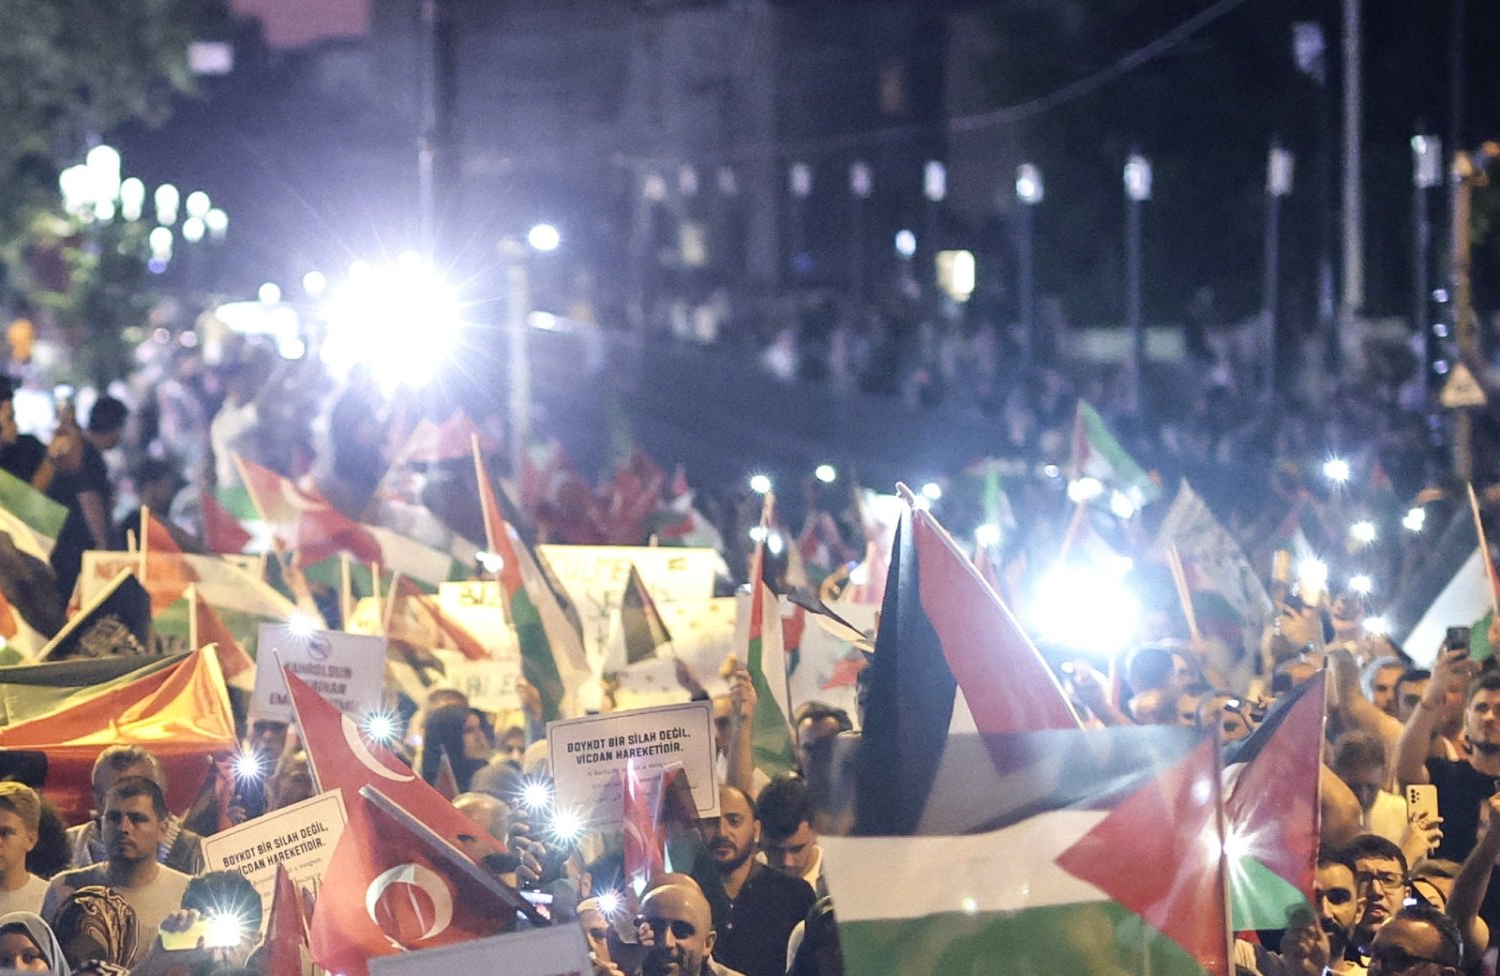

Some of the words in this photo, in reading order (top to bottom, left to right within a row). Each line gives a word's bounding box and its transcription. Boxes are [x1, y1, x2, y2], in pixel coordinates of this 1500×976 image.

[567, 738, 605, 753] BOYKOT
[608, 735, 626, 748] BİR
[628, 731, 657, 745] SİLAH
[576, 751, 613, 765] VİCDAN
[222, 847, 256, 868] BOYKOT
[257, 841, 273, 855] BİR
[273, 832, 299, 849] SİLAH
[237, 859, 266, 876] İCDAN
